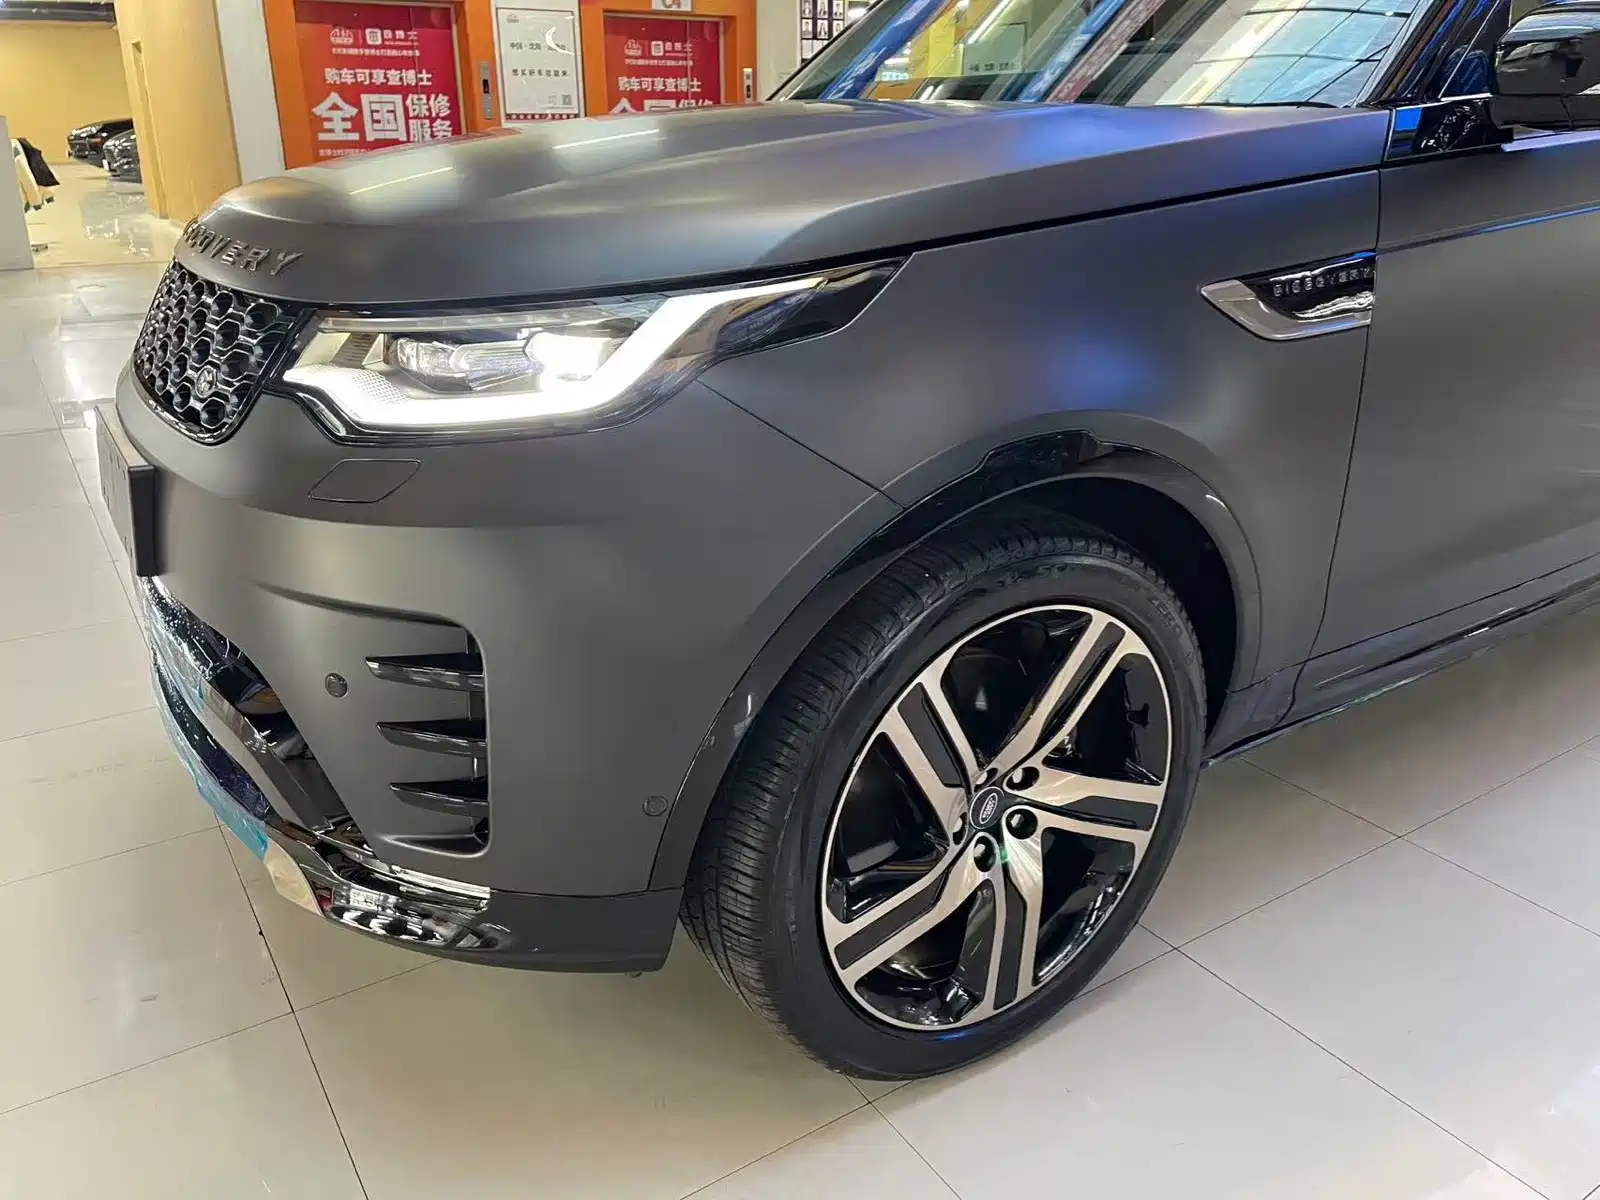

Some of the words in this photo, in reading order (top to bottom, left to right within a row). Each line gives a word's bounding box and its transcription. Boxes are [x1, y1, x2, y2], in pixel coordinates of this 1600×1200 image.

[324, 68, 432, 86] 购车可享查博士
[617, 76, 702, 92] 购车可享查博士
[312, 91, 407, 142] 全国
[405, 93, 451, 118] 保修
[409, 119, 453, 143] 服务
